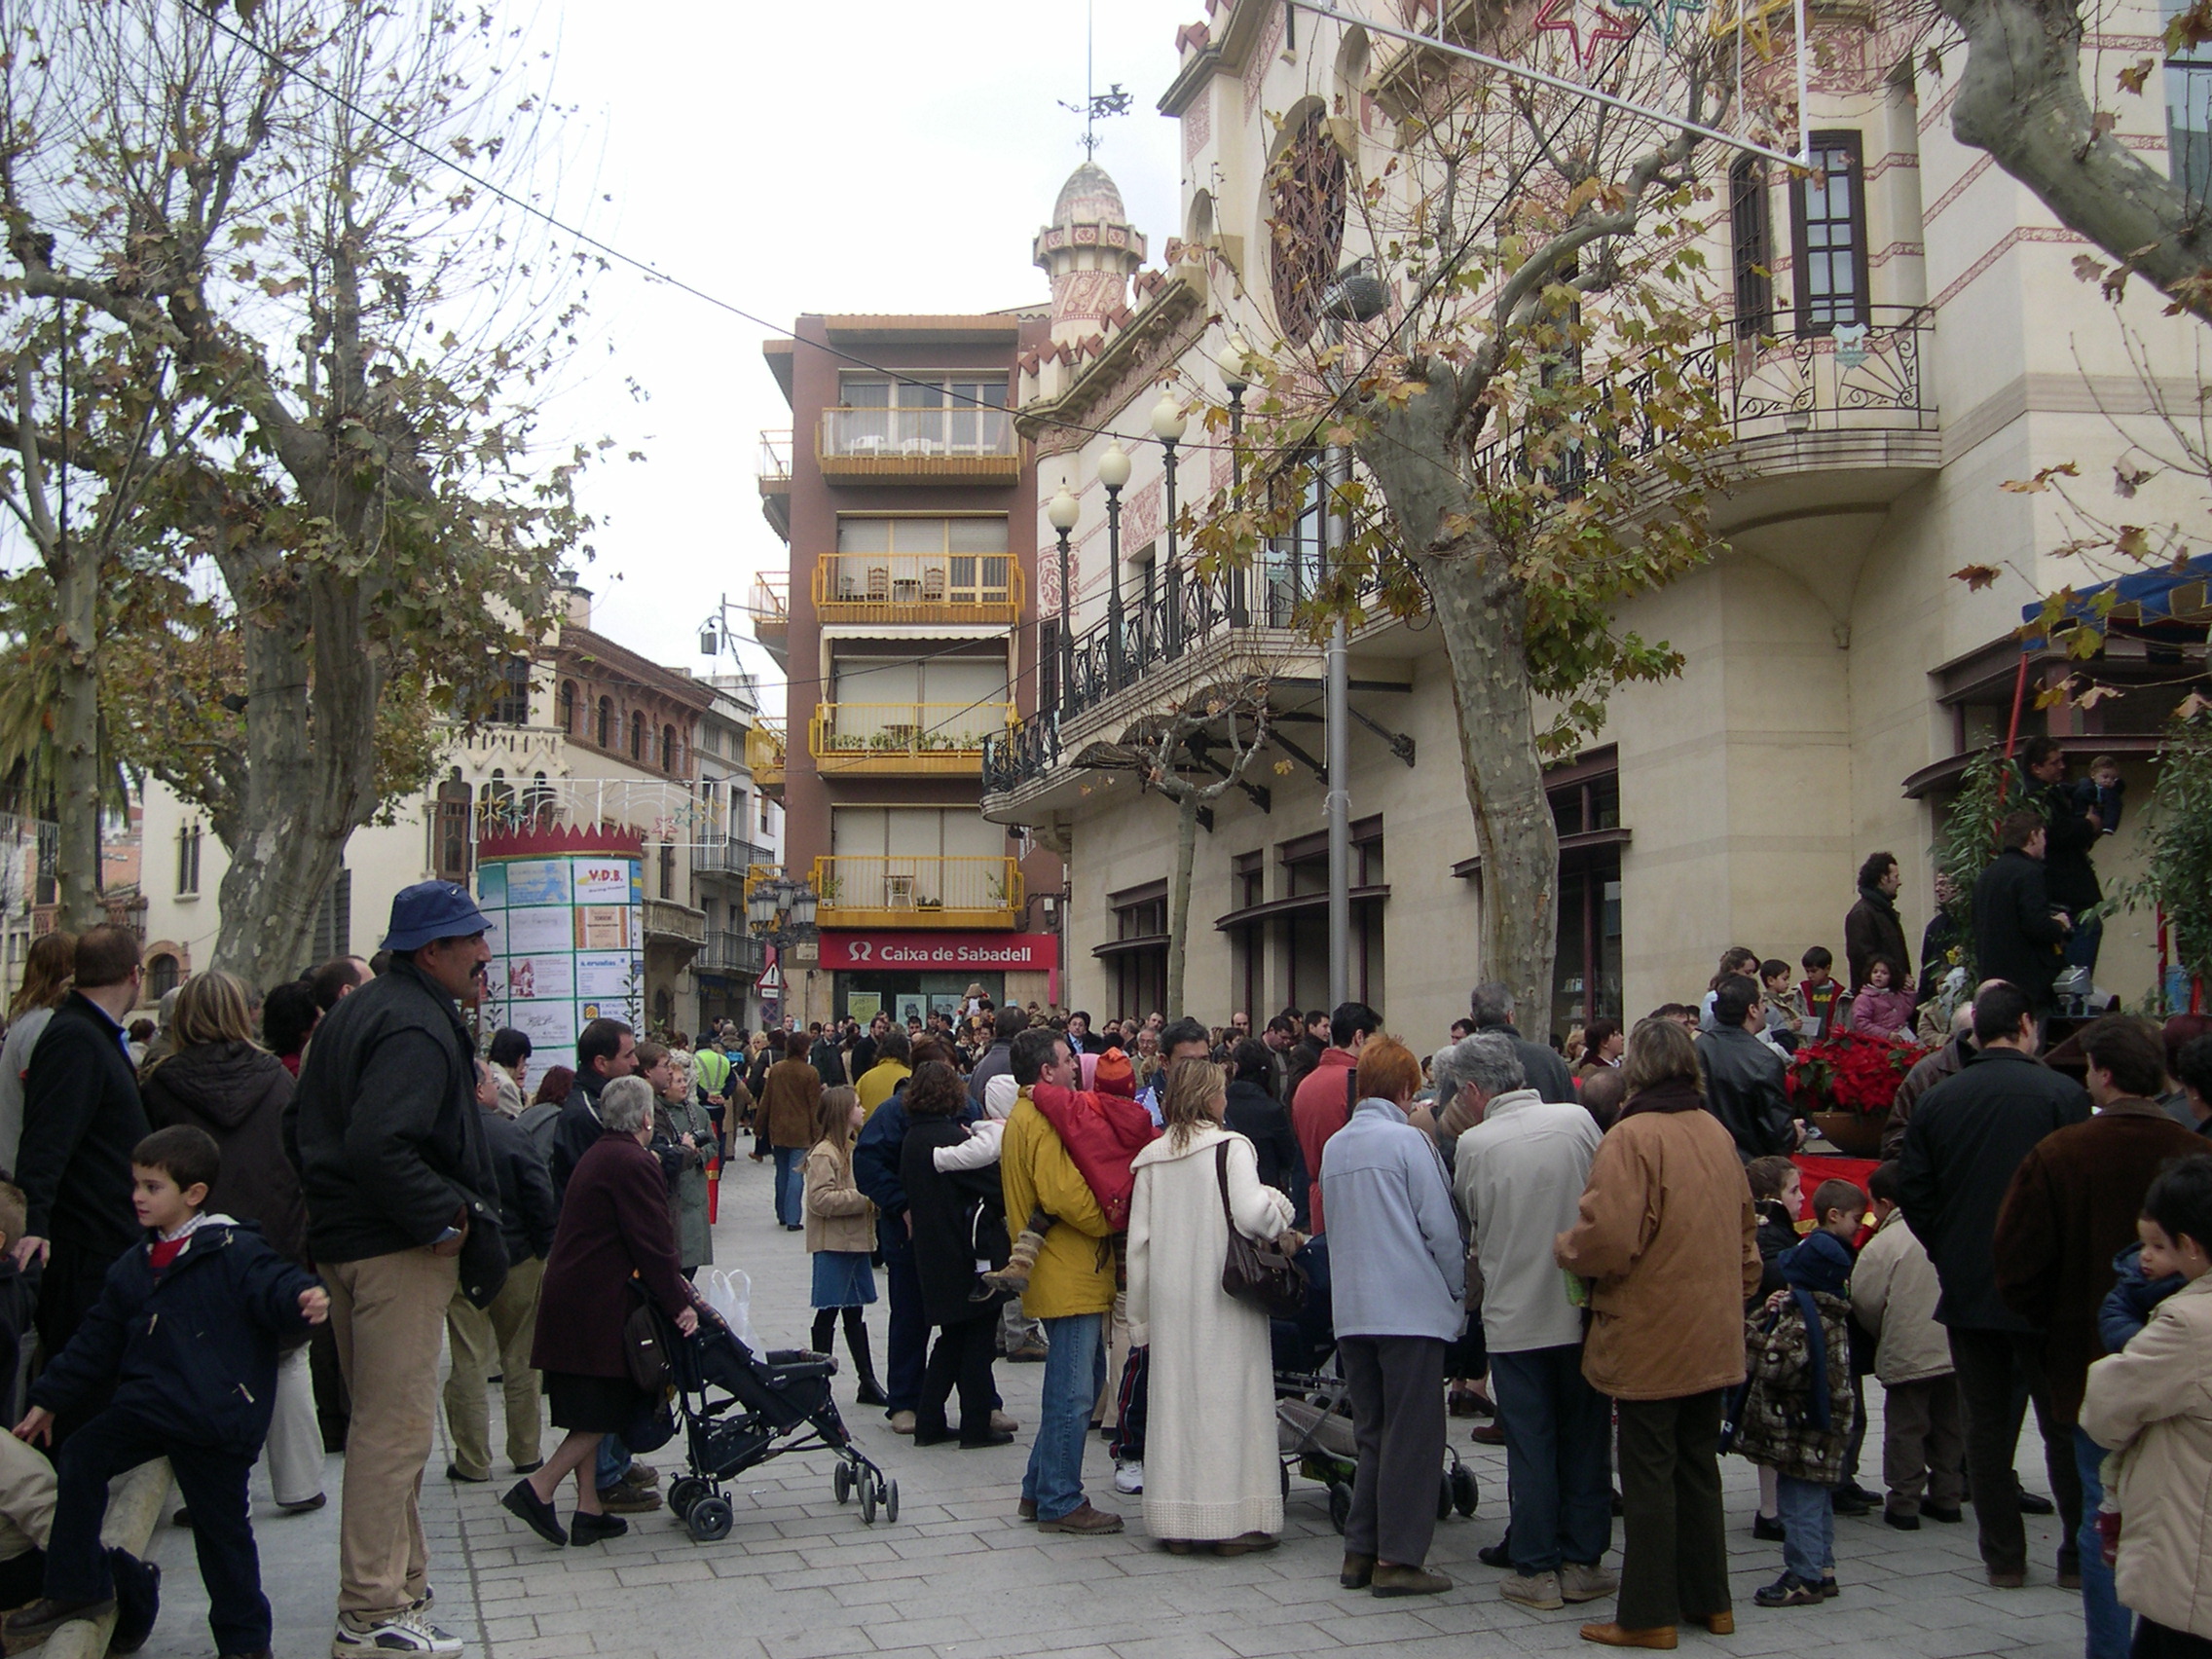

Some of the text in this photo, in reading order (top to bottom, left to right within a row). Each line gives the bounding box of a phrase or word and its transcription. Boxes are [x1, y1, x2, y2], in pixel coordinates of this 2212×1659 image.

[588, 869, 624, 881] V.D.B.
[880, 946, 1031, 962] Caixa de Sabadell
